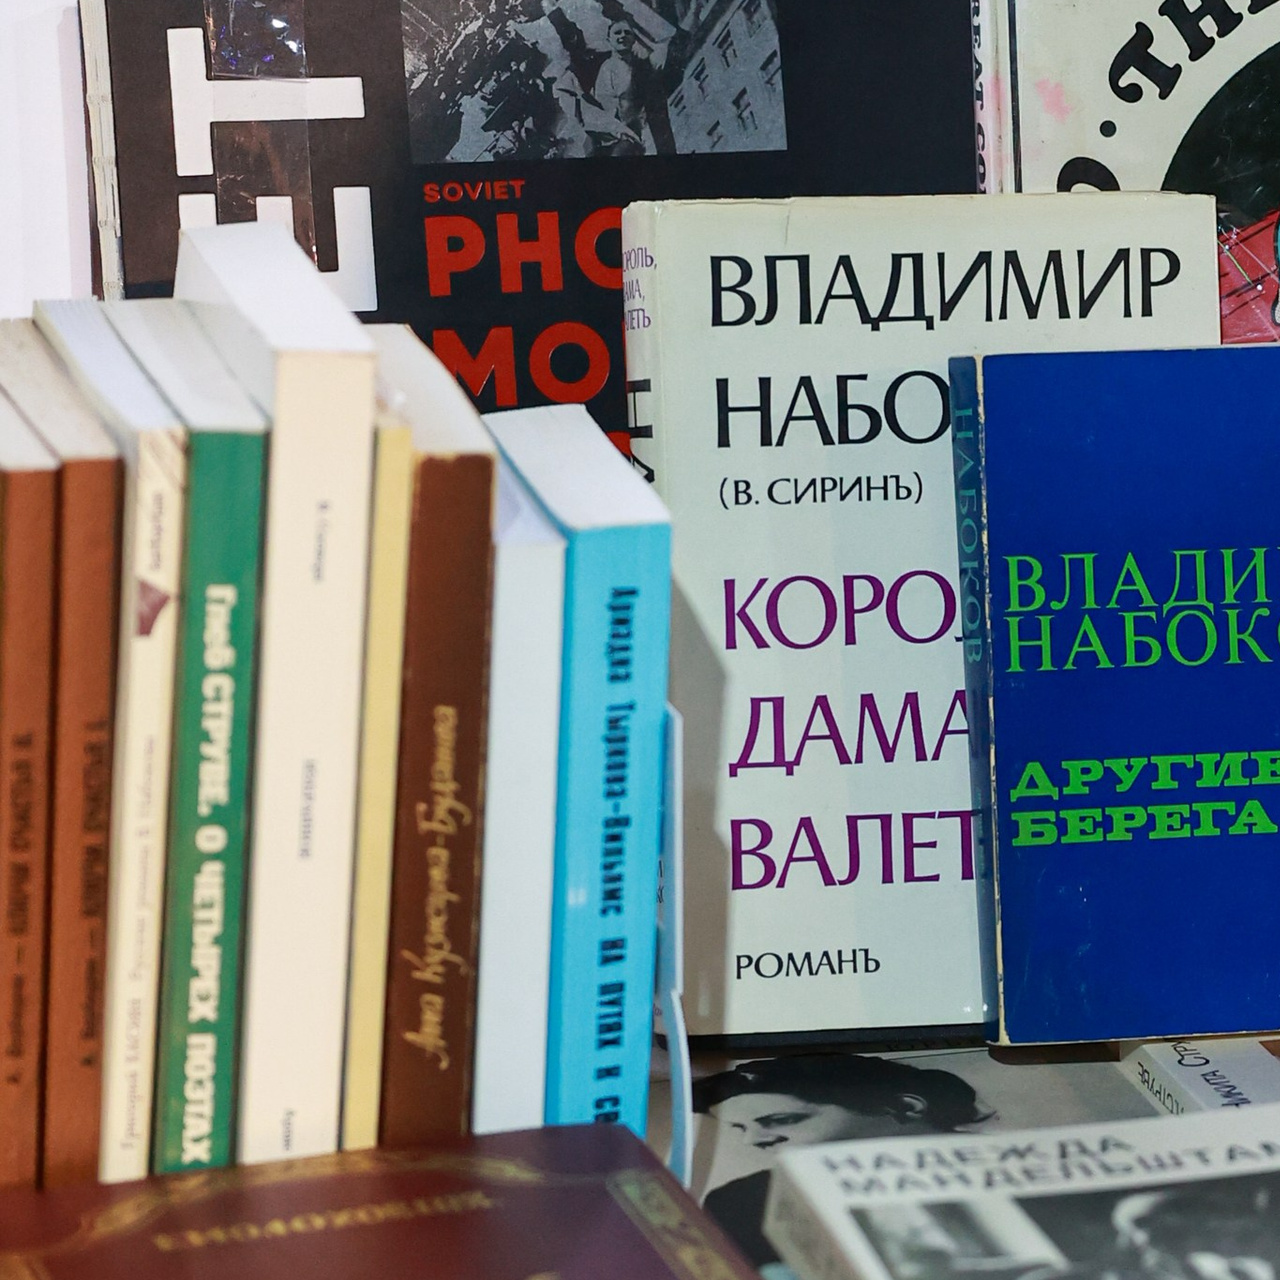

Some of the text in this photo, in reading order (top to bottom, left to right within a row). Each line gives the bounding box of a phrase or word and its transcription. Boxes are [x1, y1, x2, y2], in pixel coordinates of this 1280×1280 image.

[424, 179, 526, 203] SOVIET
[710, 247, 1181, 331] ВЛАДИМИР
[715, 371, 951, 448] НАБО
[719, 471, 923, 510] (В. СИРИНЪ)
[954, 407, 983, 664] НАБОКОВ
[1011, 799, 1279, 847] БЕРЕГА
[735, 948, 881, 980] РОМАНЪ
[817, 1133, 1138, 1175] НАДЕЖДА
